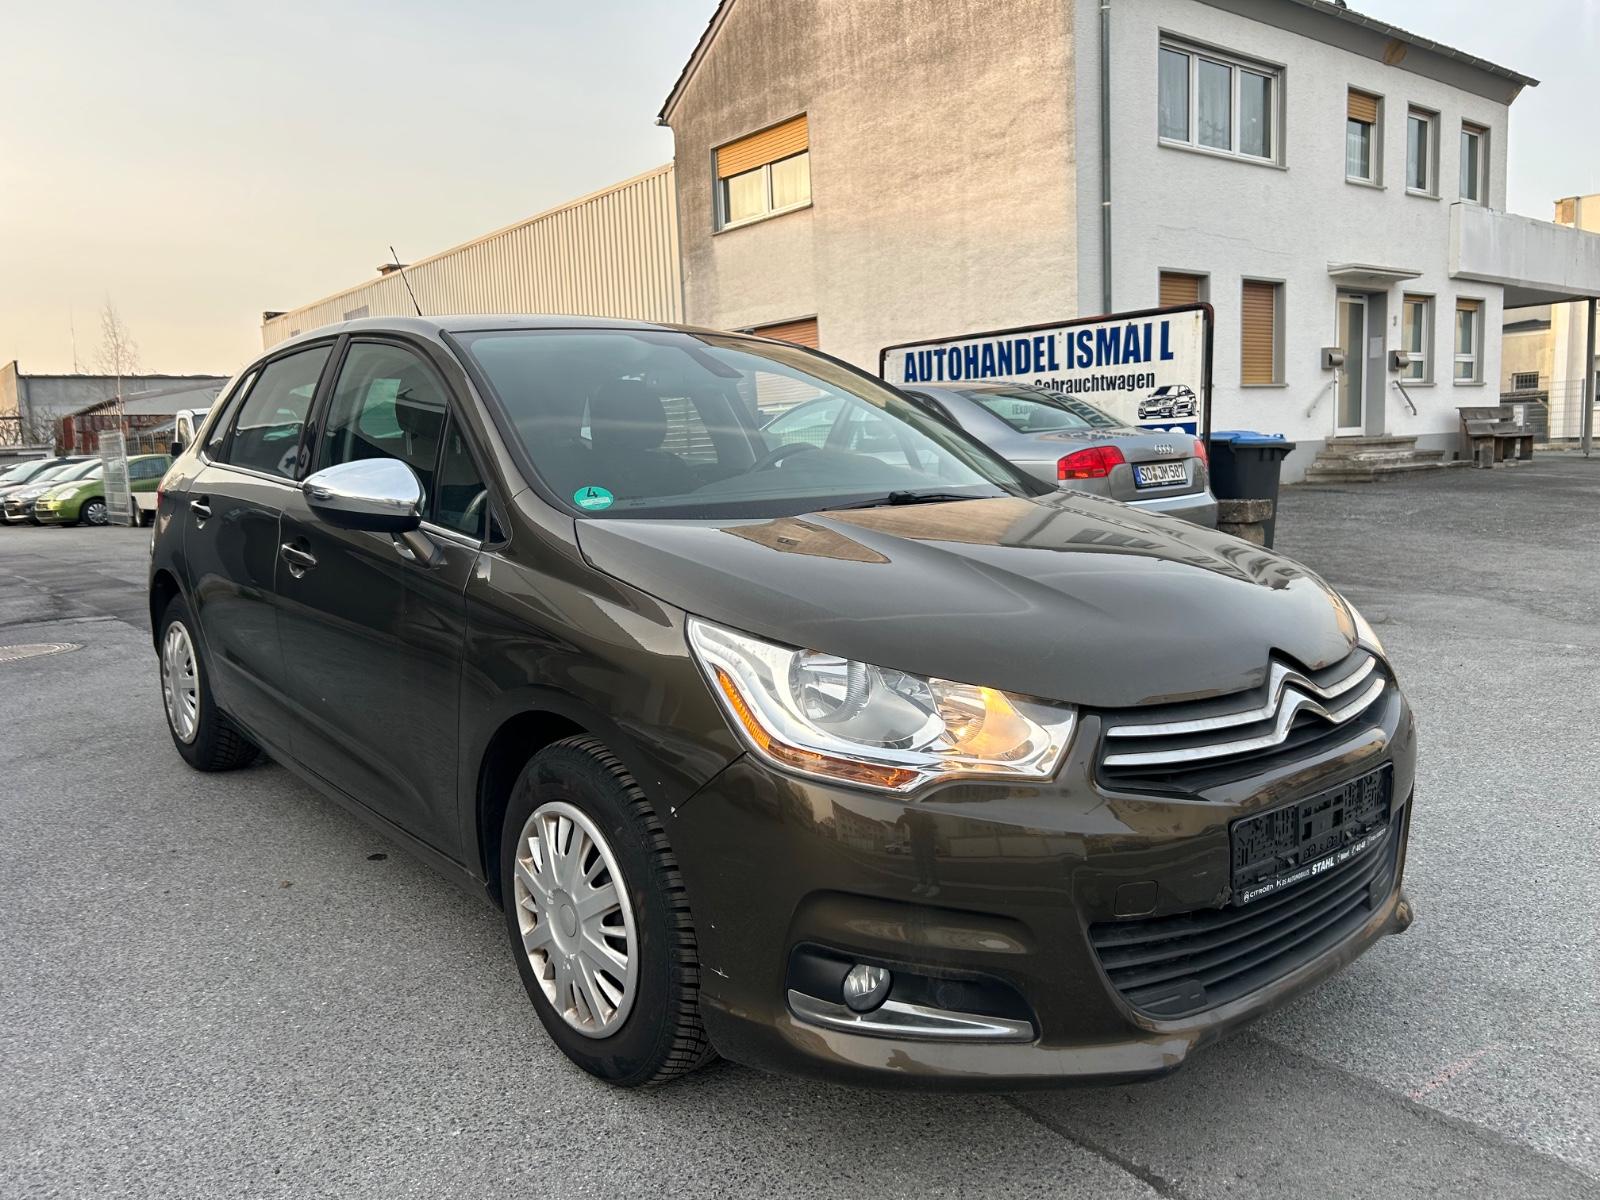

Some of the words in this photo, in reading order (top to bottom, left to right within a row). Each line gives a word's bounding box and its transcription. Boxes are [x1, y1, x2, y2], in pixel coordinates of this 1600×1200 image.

[904, 335, 1060, 383] AUTOHANDEL
[1067, 320, 1174, 370] ISMAIL
[586, 487, 598, 498] 4
[1312, 856, 1335, 875] STAHL
